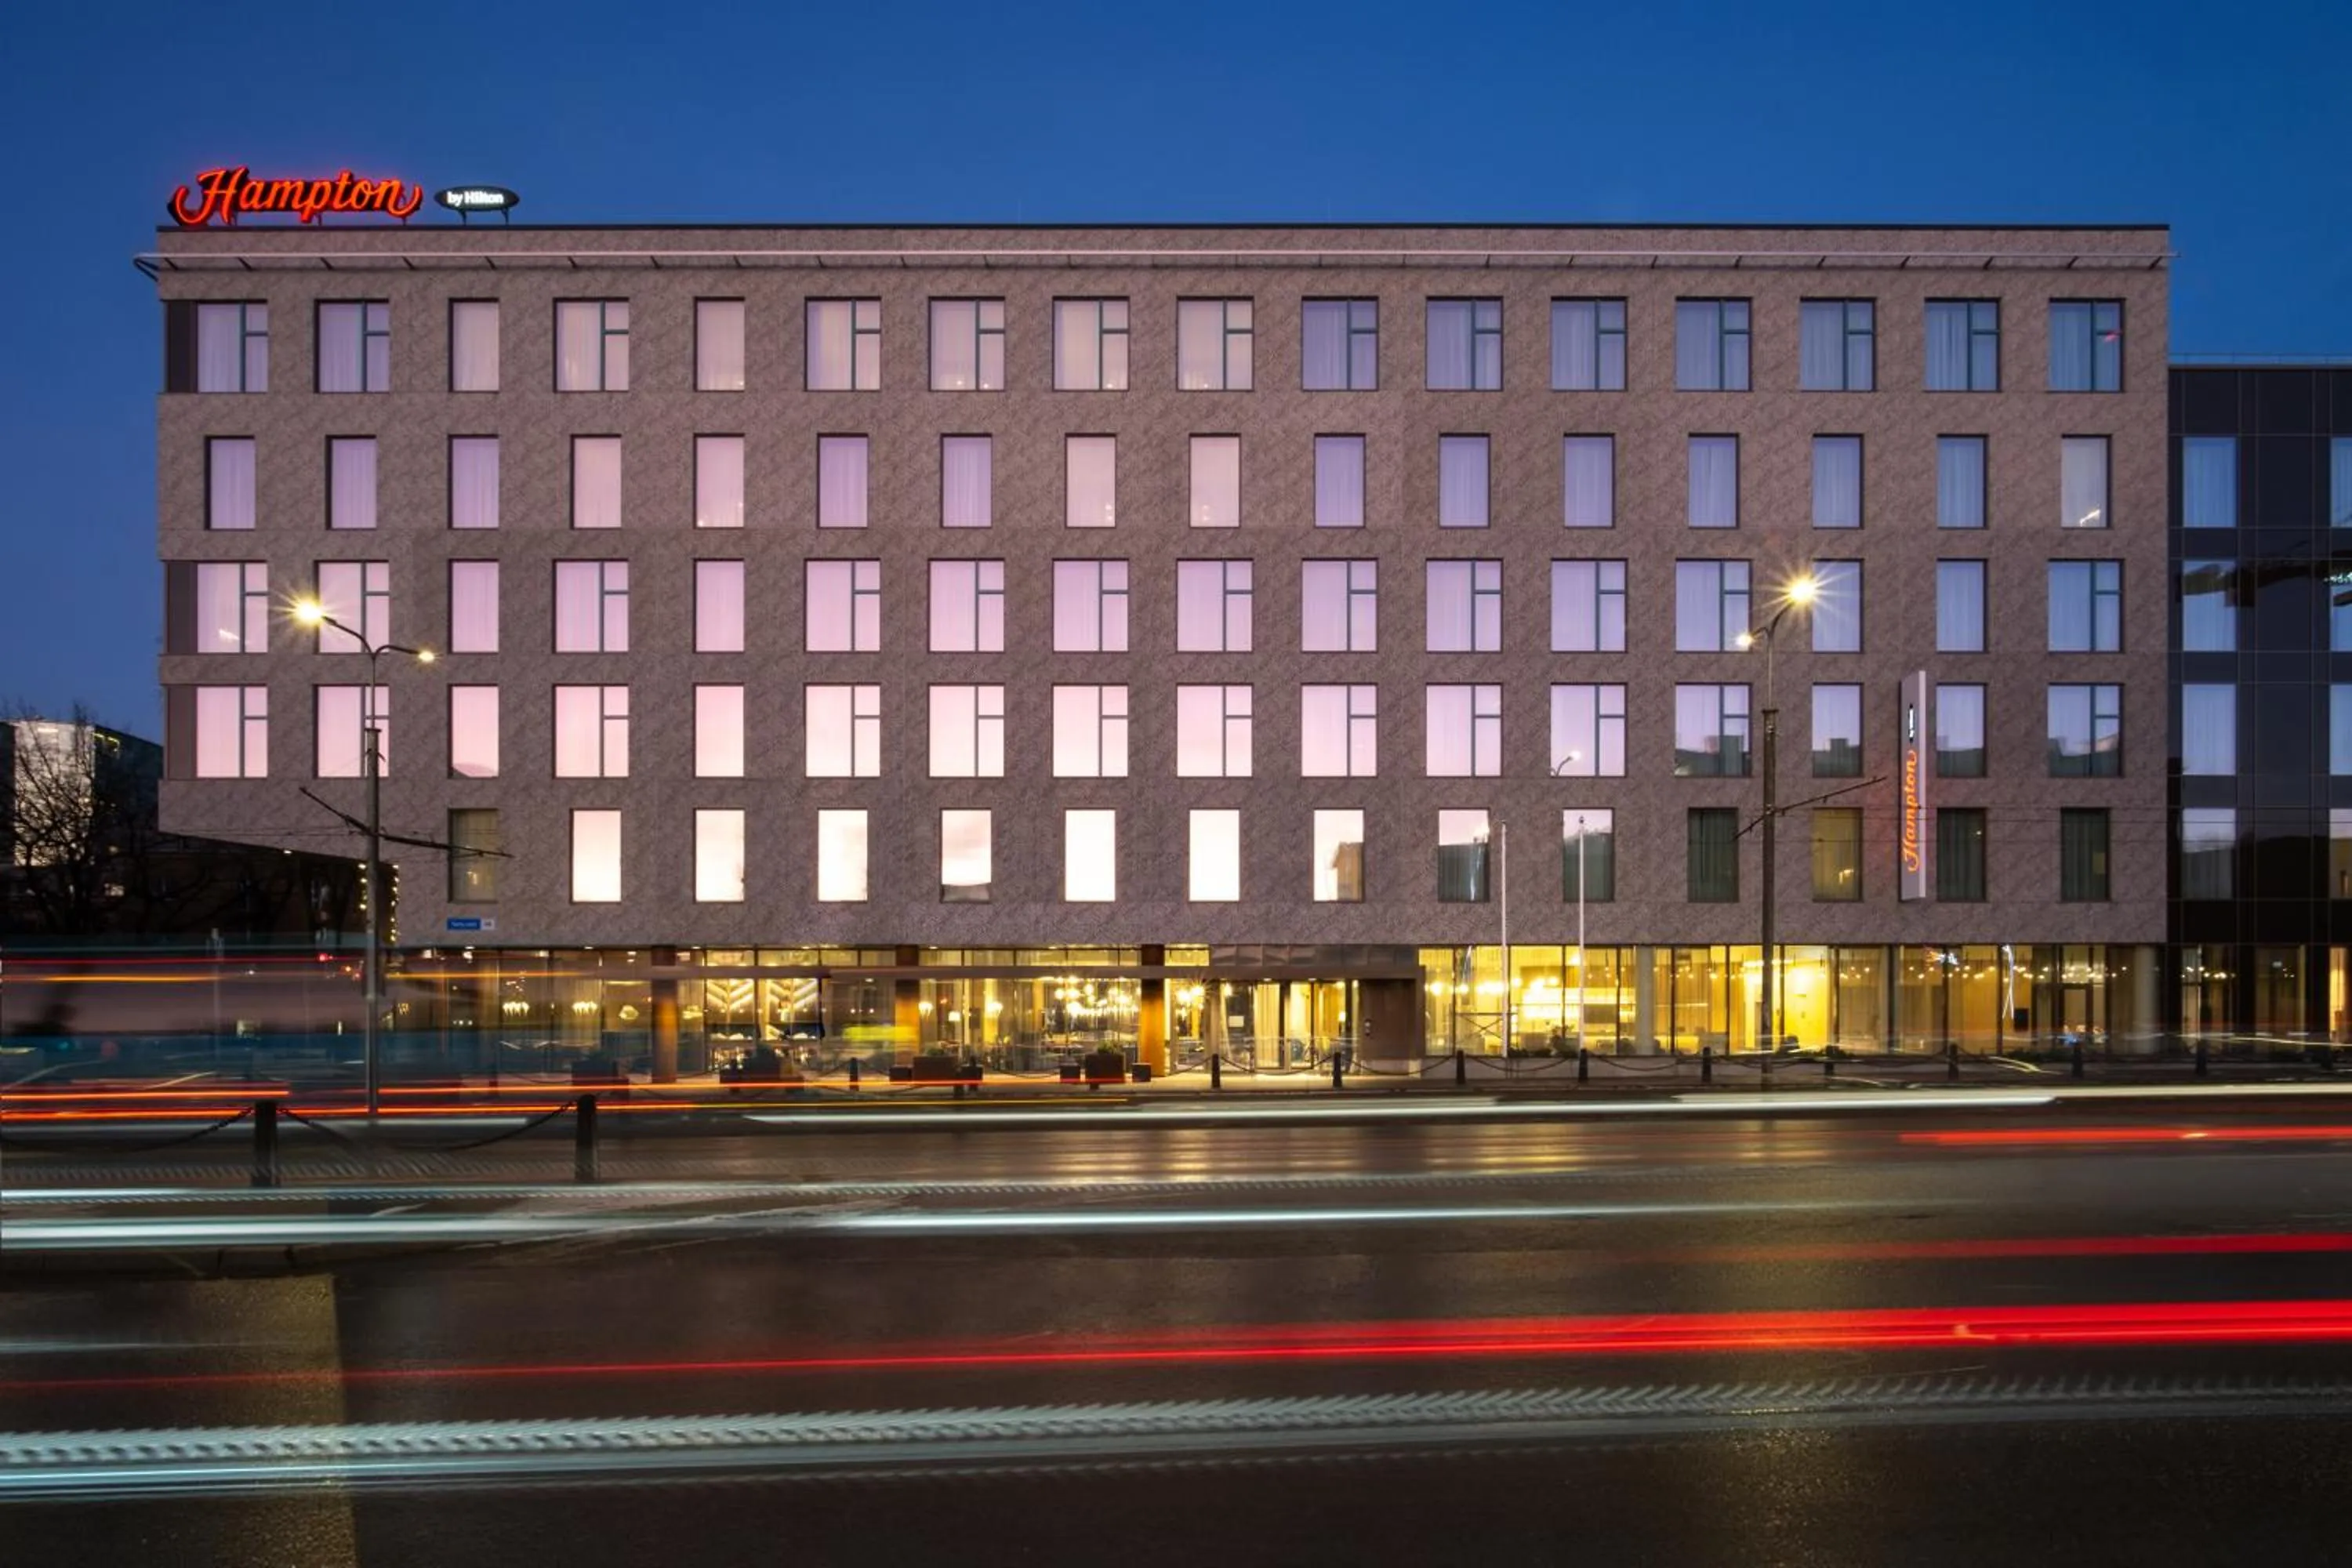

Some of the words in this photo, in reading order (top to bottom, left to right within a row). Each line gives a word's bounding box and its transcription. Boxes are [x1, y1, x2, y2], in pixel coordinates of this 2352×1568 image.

[171, 165, 422, 226] Hampton
[446, 191, 463, 207] by
[464, 191, 505, 205] Hilton
[1902, 750, 1919, 872] Hampton
